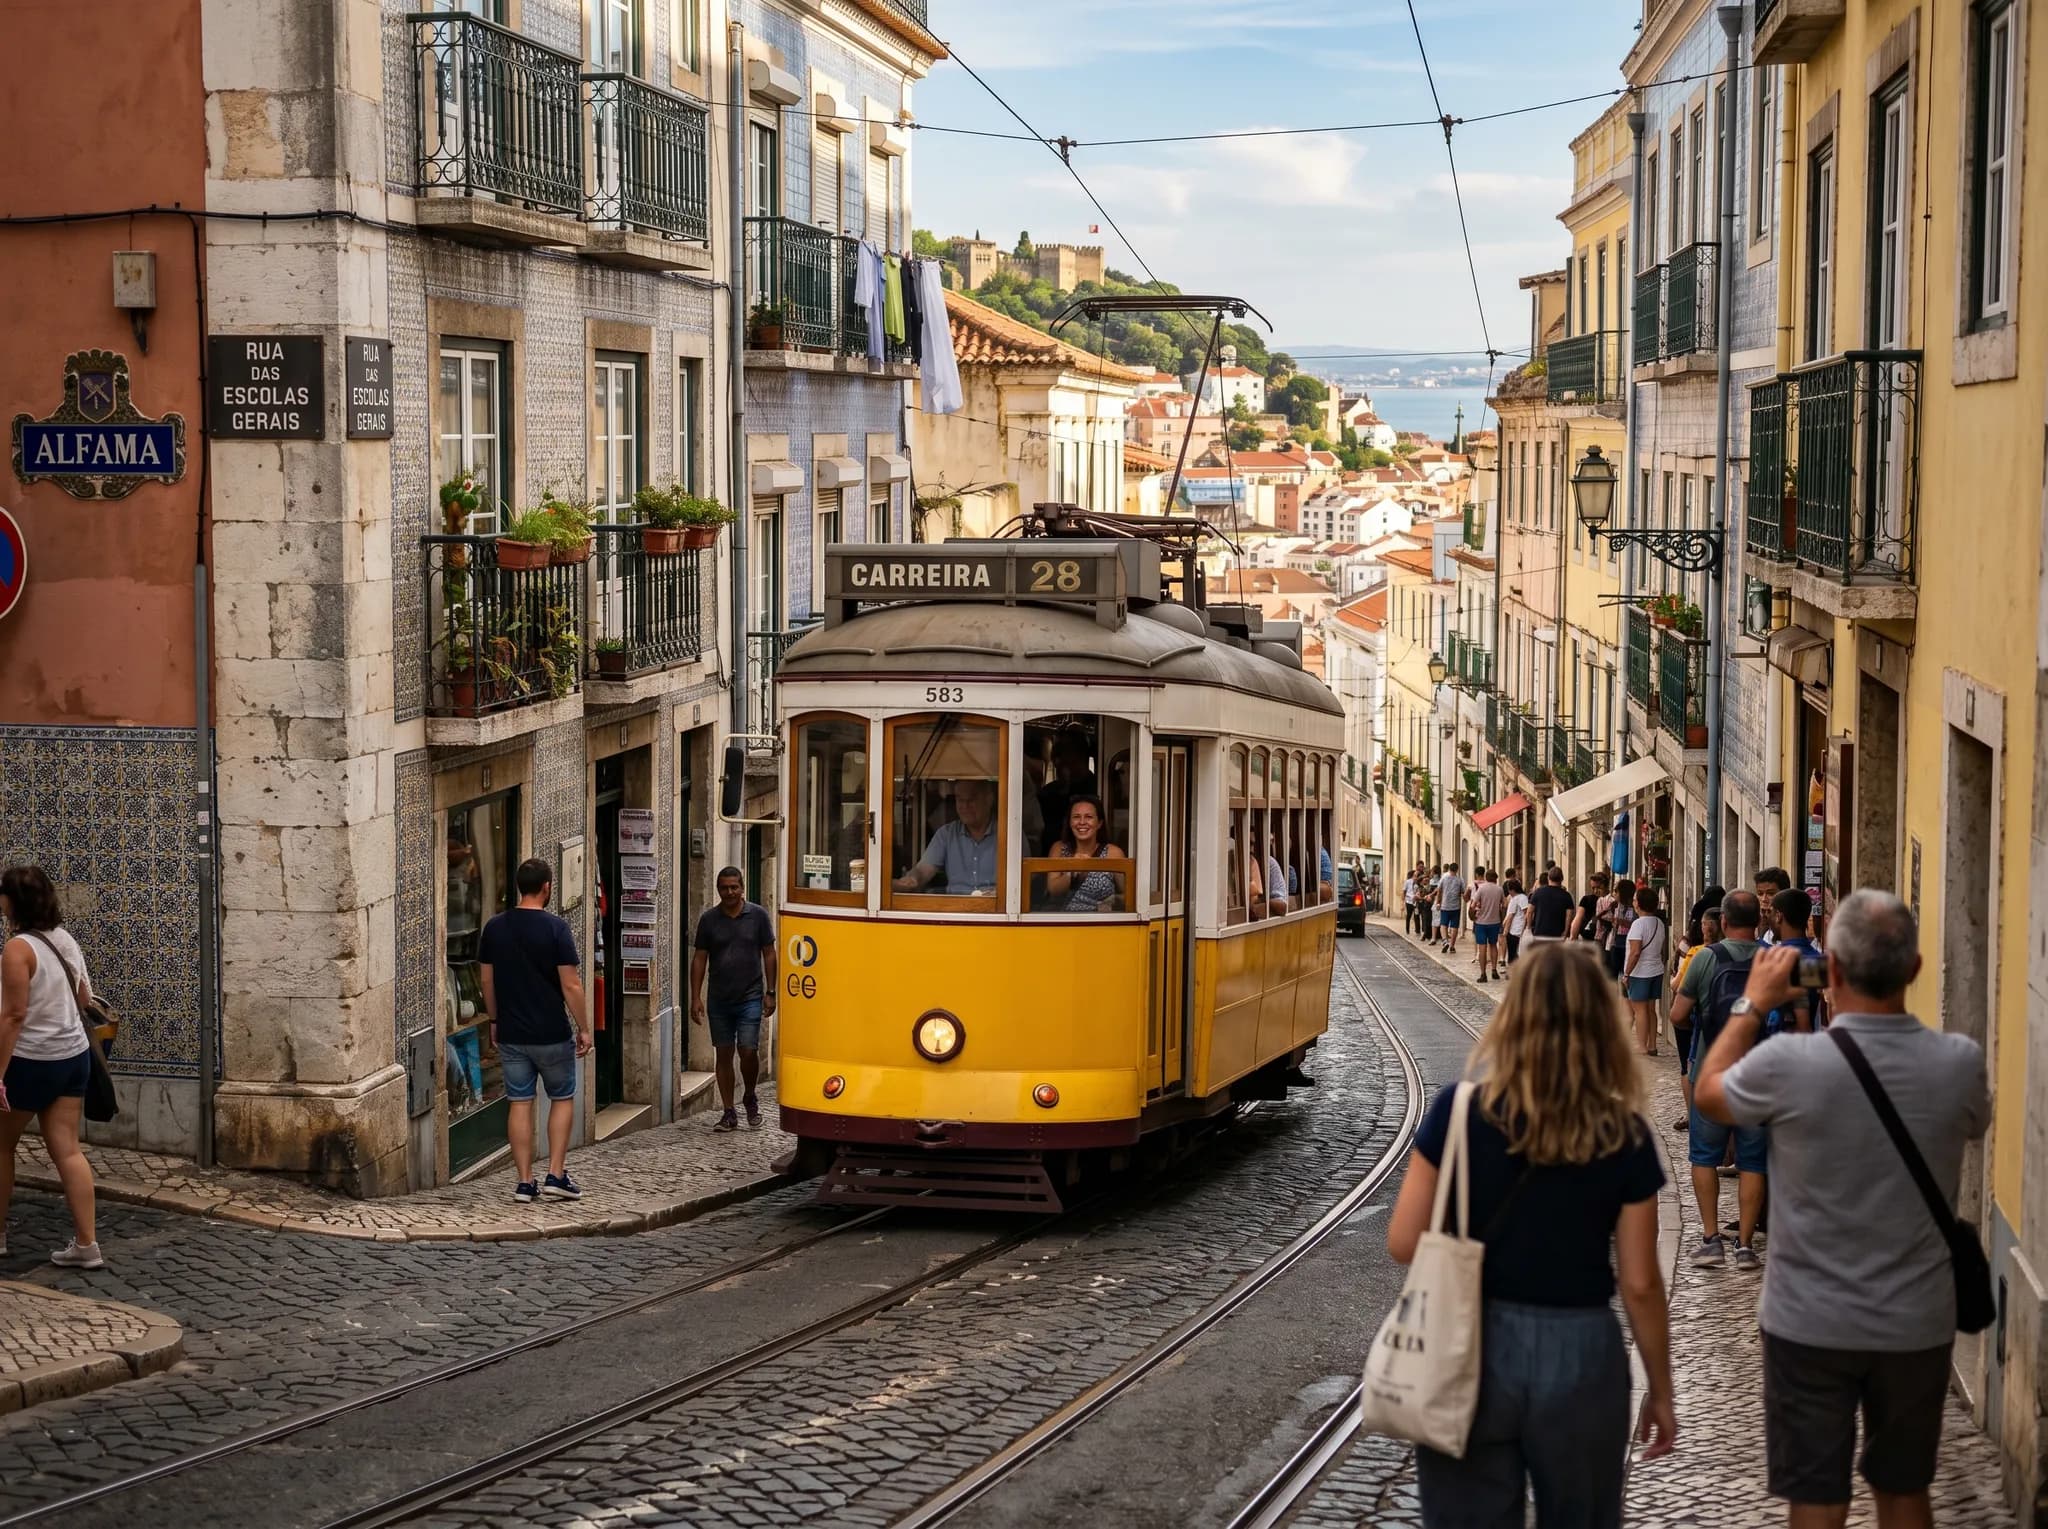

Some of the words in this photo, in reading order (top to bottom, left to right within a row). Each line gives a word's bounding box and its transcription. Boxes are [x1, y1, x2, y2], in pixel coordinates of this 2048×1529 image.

[246, 343, 284, 360] RUA
[363, 344, 380, 362] RUA
[251, 366, 280, 381] DAS
[223, 387, 309, 405] ESCOLAS
[353, 387, 389, 406] ESCOLAS
[232, 411, 300, 430] GERAIS
[357, 413, 386, 431] GERAIS
[34, 433, 161, 465] ALFAMA
[851, 563, 991, 587] CARREIRA
[1030, 560, 1081, 592] 28
[926, 687, 964, 703] 583
